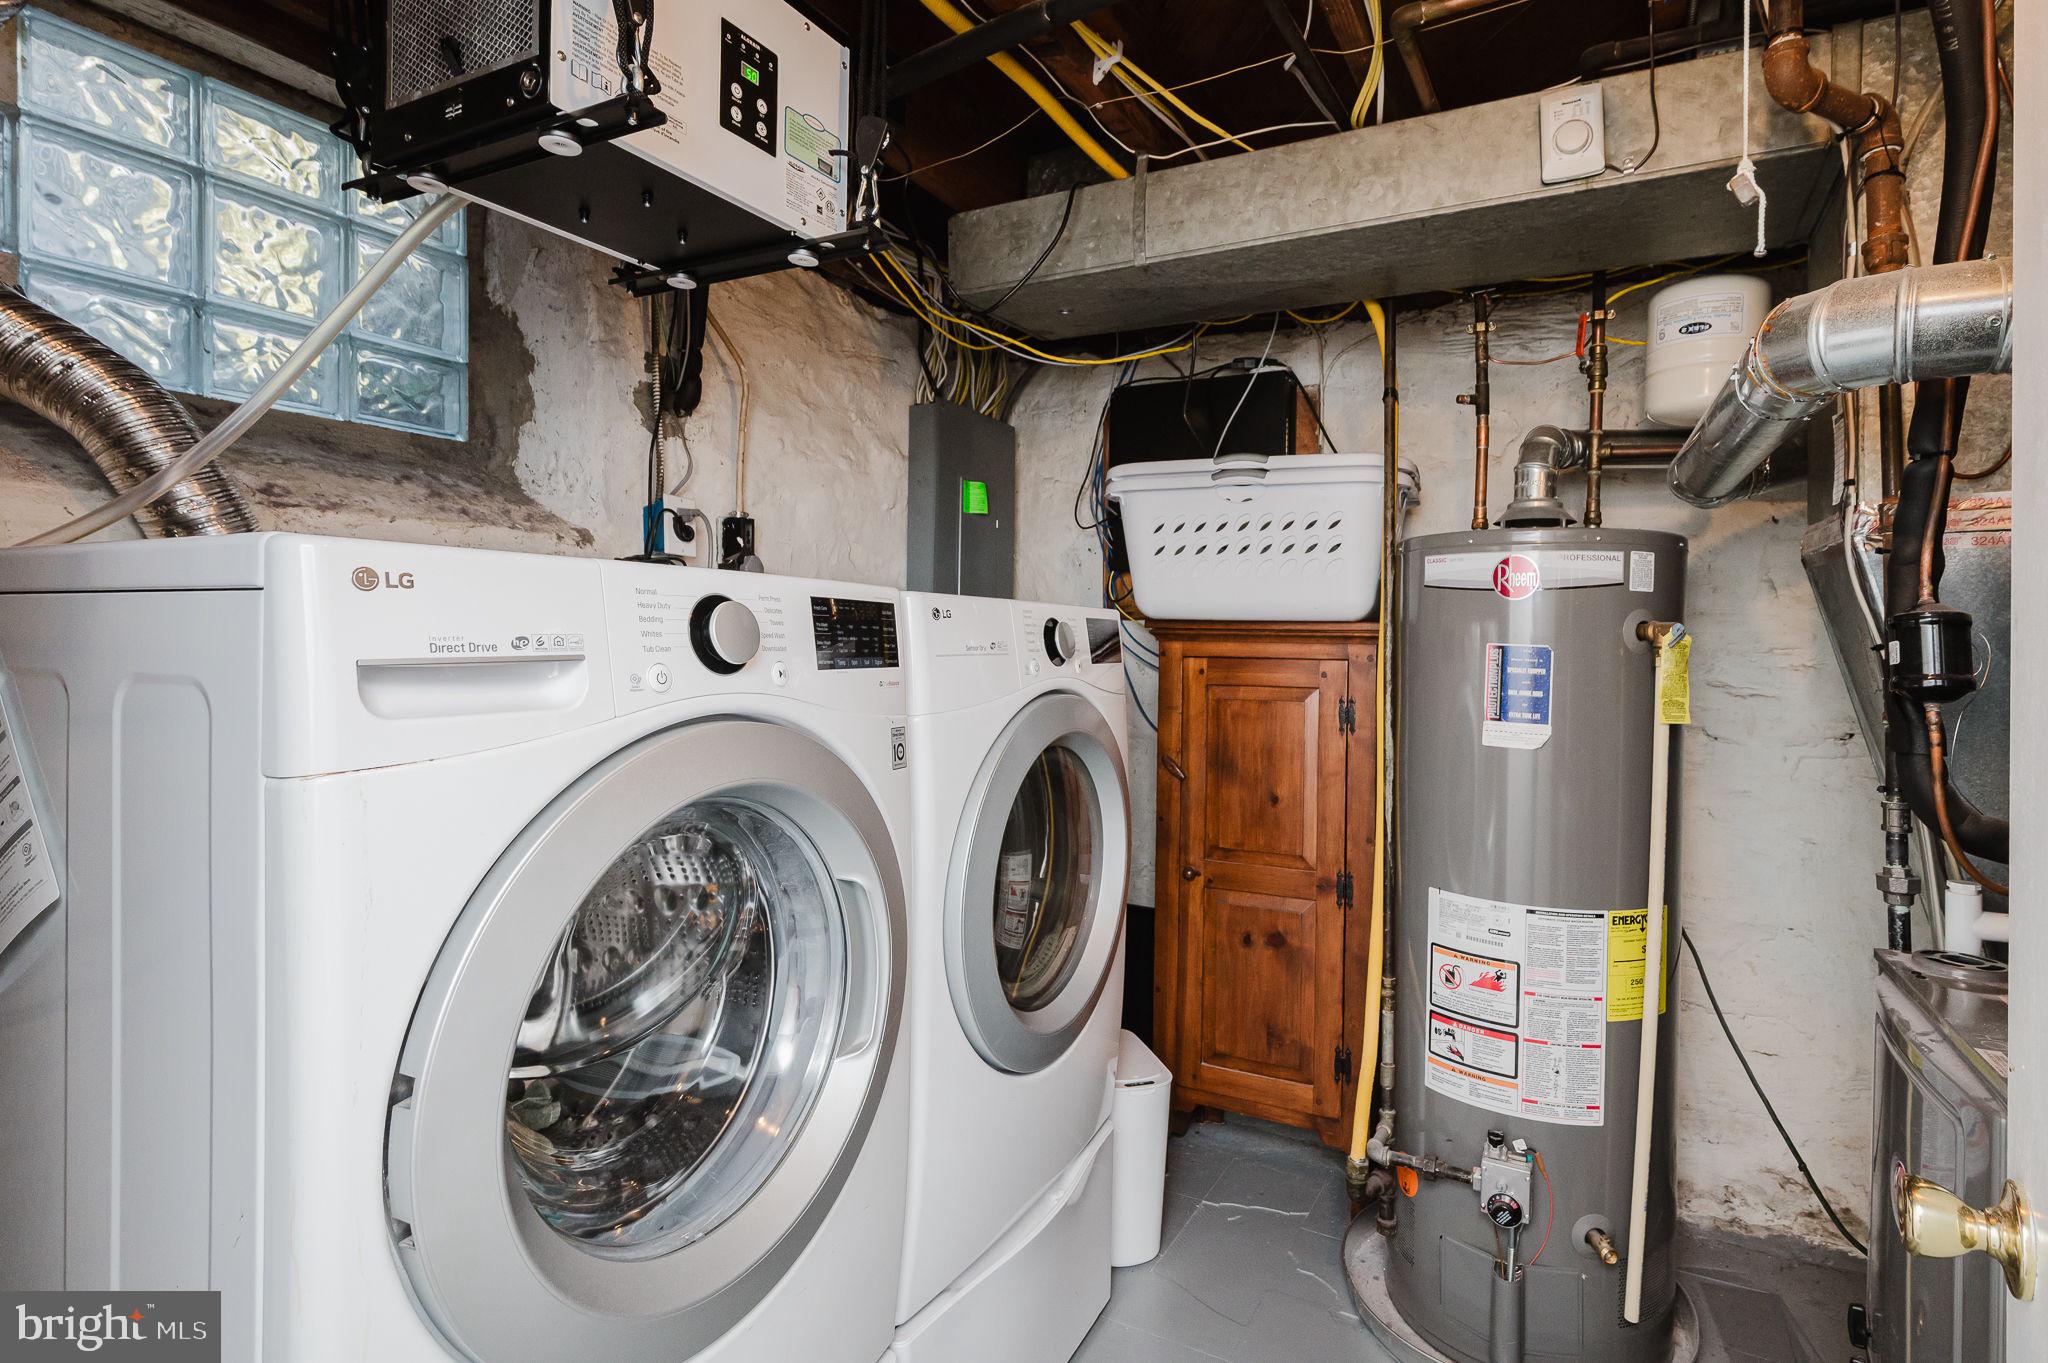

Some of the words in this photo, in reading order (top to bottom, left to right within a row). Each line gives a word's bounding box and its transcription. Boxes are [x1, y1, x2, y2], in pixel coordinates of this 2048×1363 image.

[1971, 535, 2006, 546] 324A
[1426, 557, 1447, 565] CLASSIC
[384, 571, 415, 590] LG
[1497, 562, 1537, 593] Rheem
[635, 587, 658, 595] Normal
[637, 602, 656, 610] Heavy
[657, 602, 671, 610] Duty
[941, 609, 952, 619] LG
[638, 615, 664, 624] Bedding
[640, 630, 663, 638] Whites
[429, 642, 466, 654] Direct
[468, 642, 498, 653] Drive
[642, 645, 655, 653] Tub
[655, 645, 672, 653] Clean
[1459, 955, 1491, 967] WARNING
[1458, 1023, 1485, 1036] DANGER
[1458, 1068, 1486, 1082] WARNING
